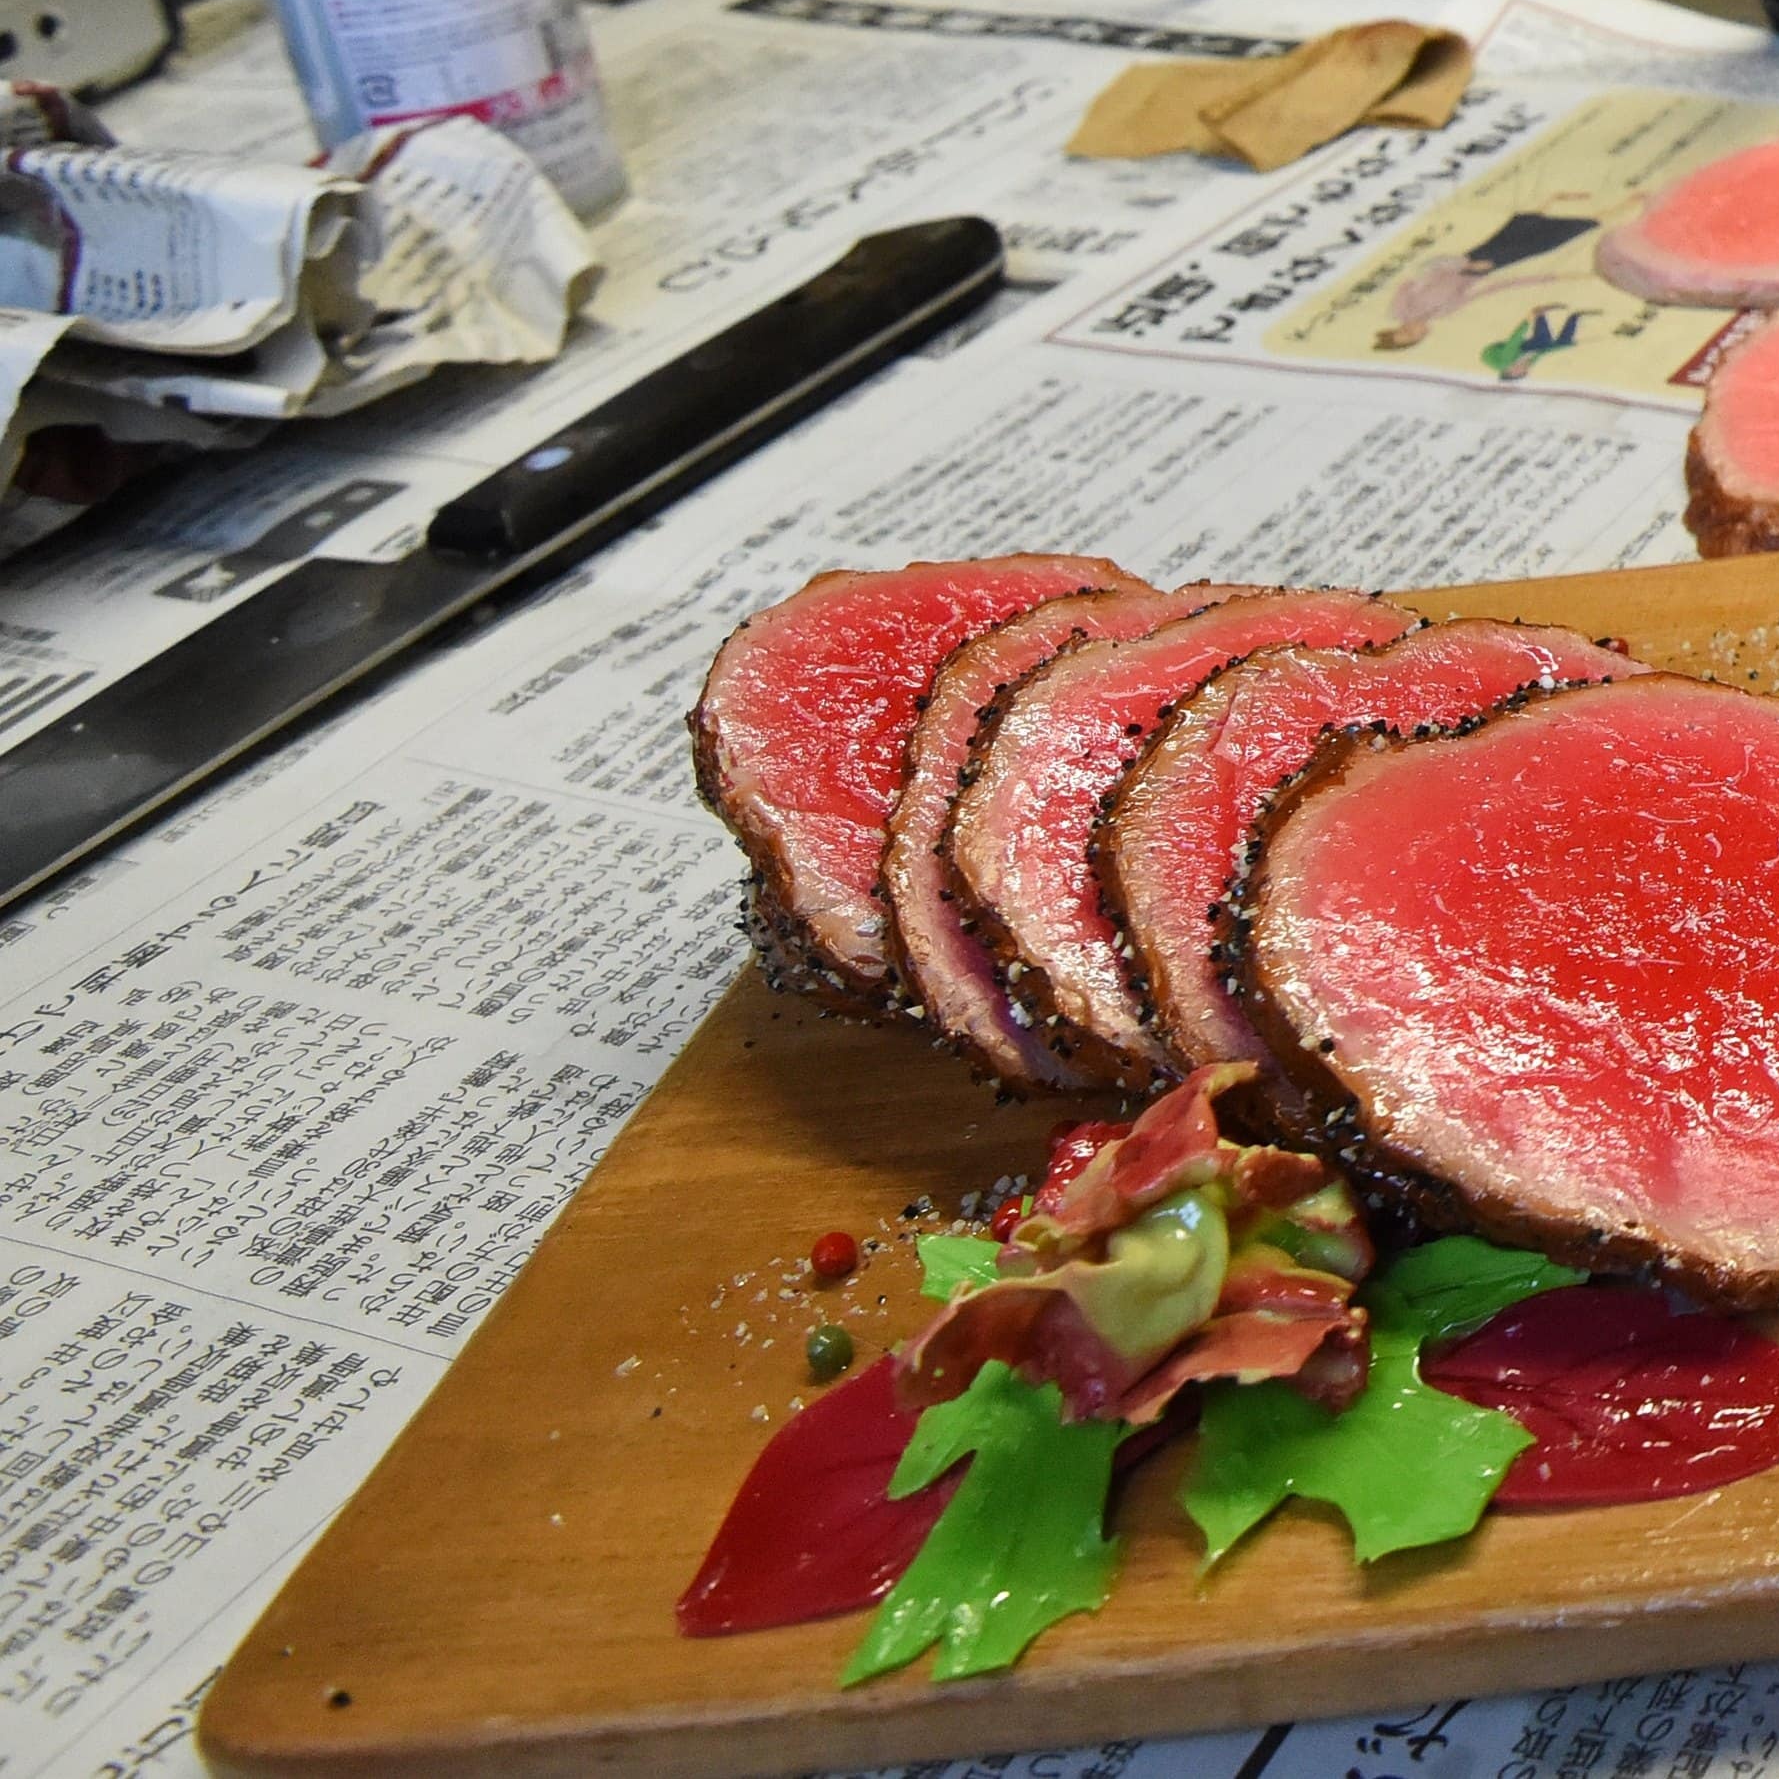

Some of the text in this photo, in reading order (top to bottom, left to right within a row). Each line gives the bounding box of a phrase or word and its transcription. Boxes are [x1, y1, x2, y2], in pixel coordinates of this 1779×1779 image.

[1, 1005, 333, 1224] んだ。片目が見えなかった
[35, 1011, 364, 1231] り視野が欠損したりして白
[67, 1019, 393, 1240] 杖を持つ人たちに「うそつ
[137, 1033, 461, 1257] と心ない言葉を発する人が
[171, 1156, 337, 1267] いるという。
[231, 1049, 526, 1258] 私の母は30代後半で難病
[276, 1063, 591, 1298] 病院までバスと地下鉄で通
[313, 1072, 624, 1304] った。病気だと他人にはわ
